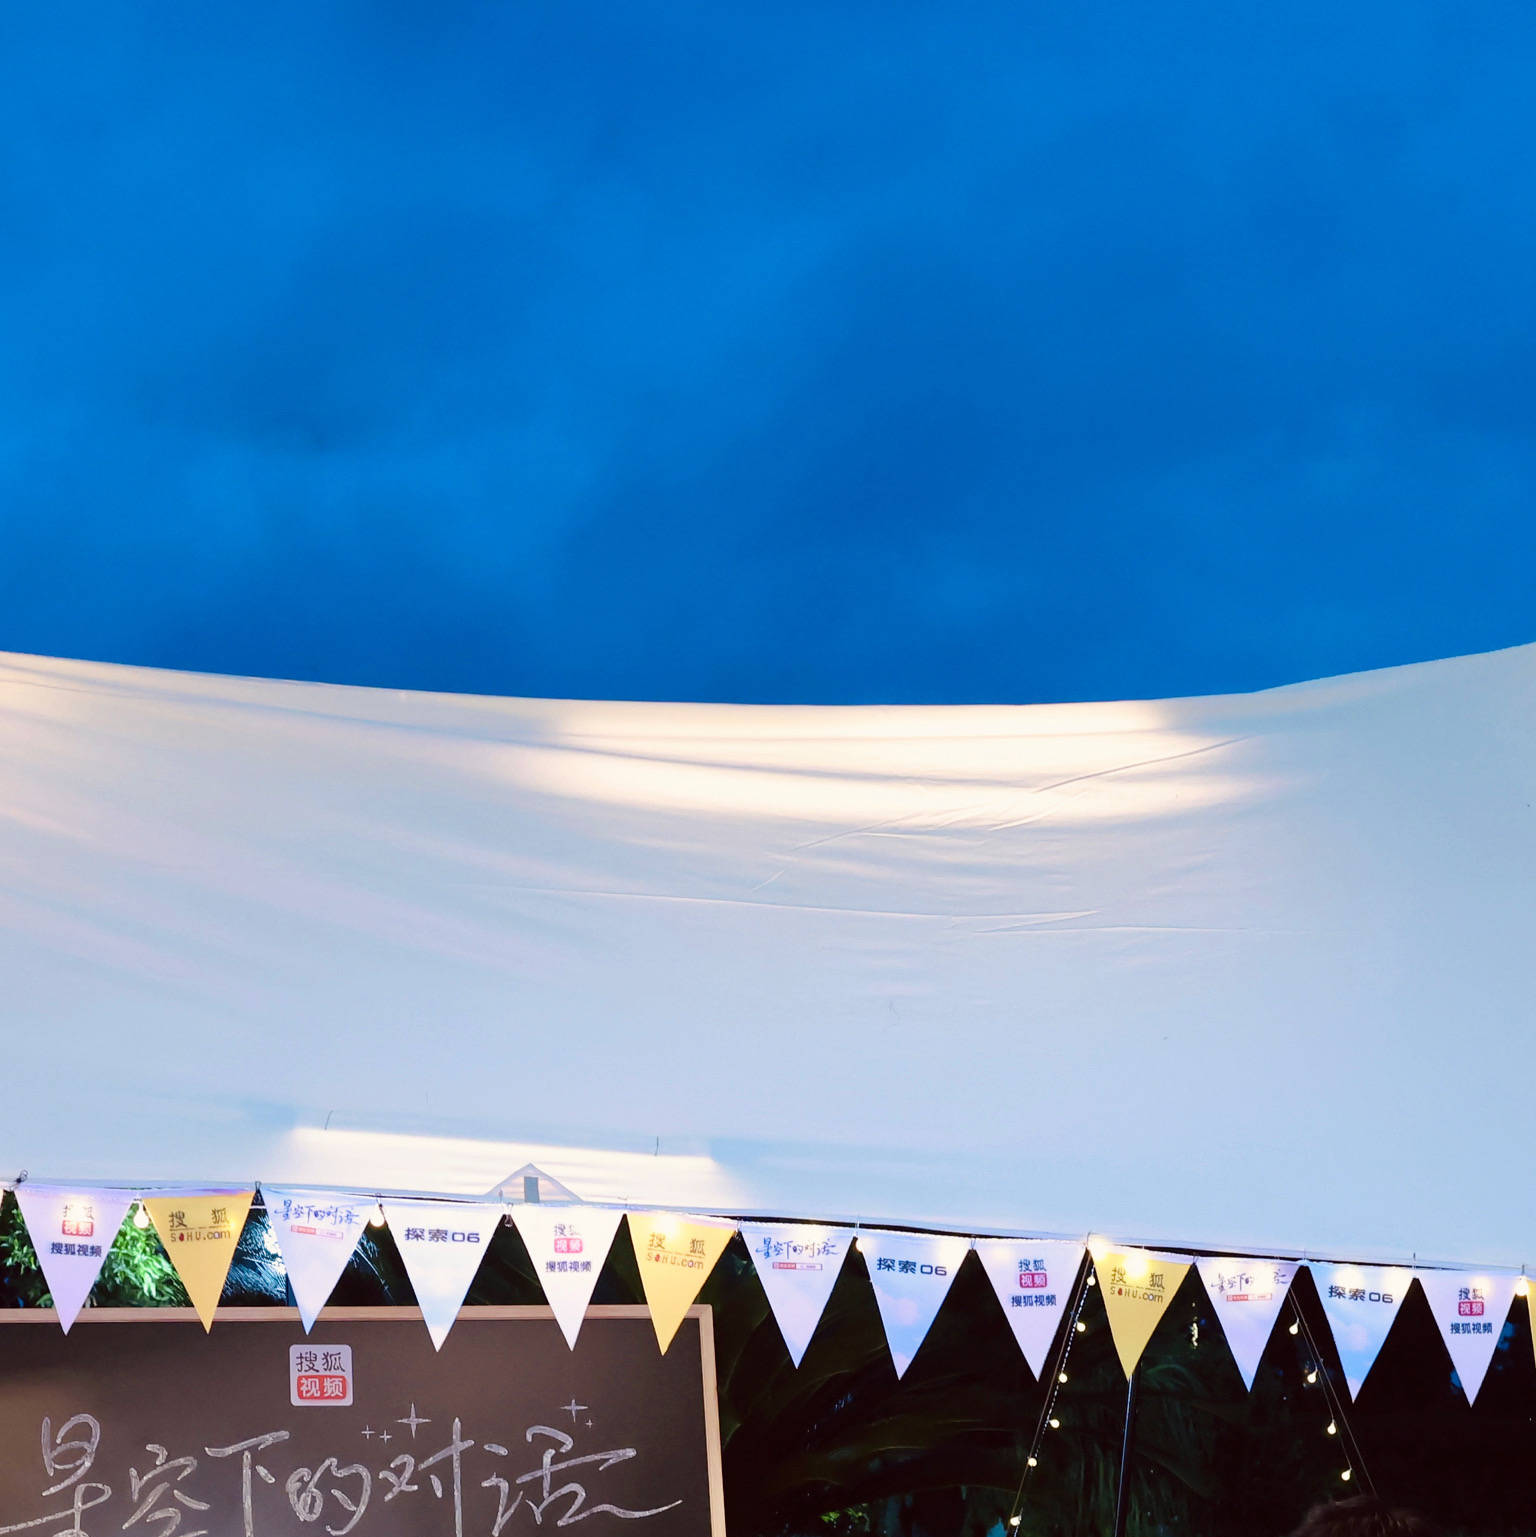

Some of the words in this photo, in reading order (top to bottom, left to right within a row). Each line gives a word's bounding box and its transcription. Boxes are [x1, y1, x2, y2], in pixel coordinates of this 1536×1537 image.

[404, 1227, 480, 1243] 探索06
[51, 1242, 102, 1257] 搜狐视频
[545, 1261, 591, 1272] 搜狐视频
[877, 1258, 947, 1276] 探索06
[1011, 1295, 1056, 1307] 搜狐视频
[1328, 1285, 1393, 1303] 探索06
[1450, 1322, 1492, 1334] 搜狐视频
[296, 1351, 346, 1372] 搜狐
[300, 1377, 345, 1399] 视频
